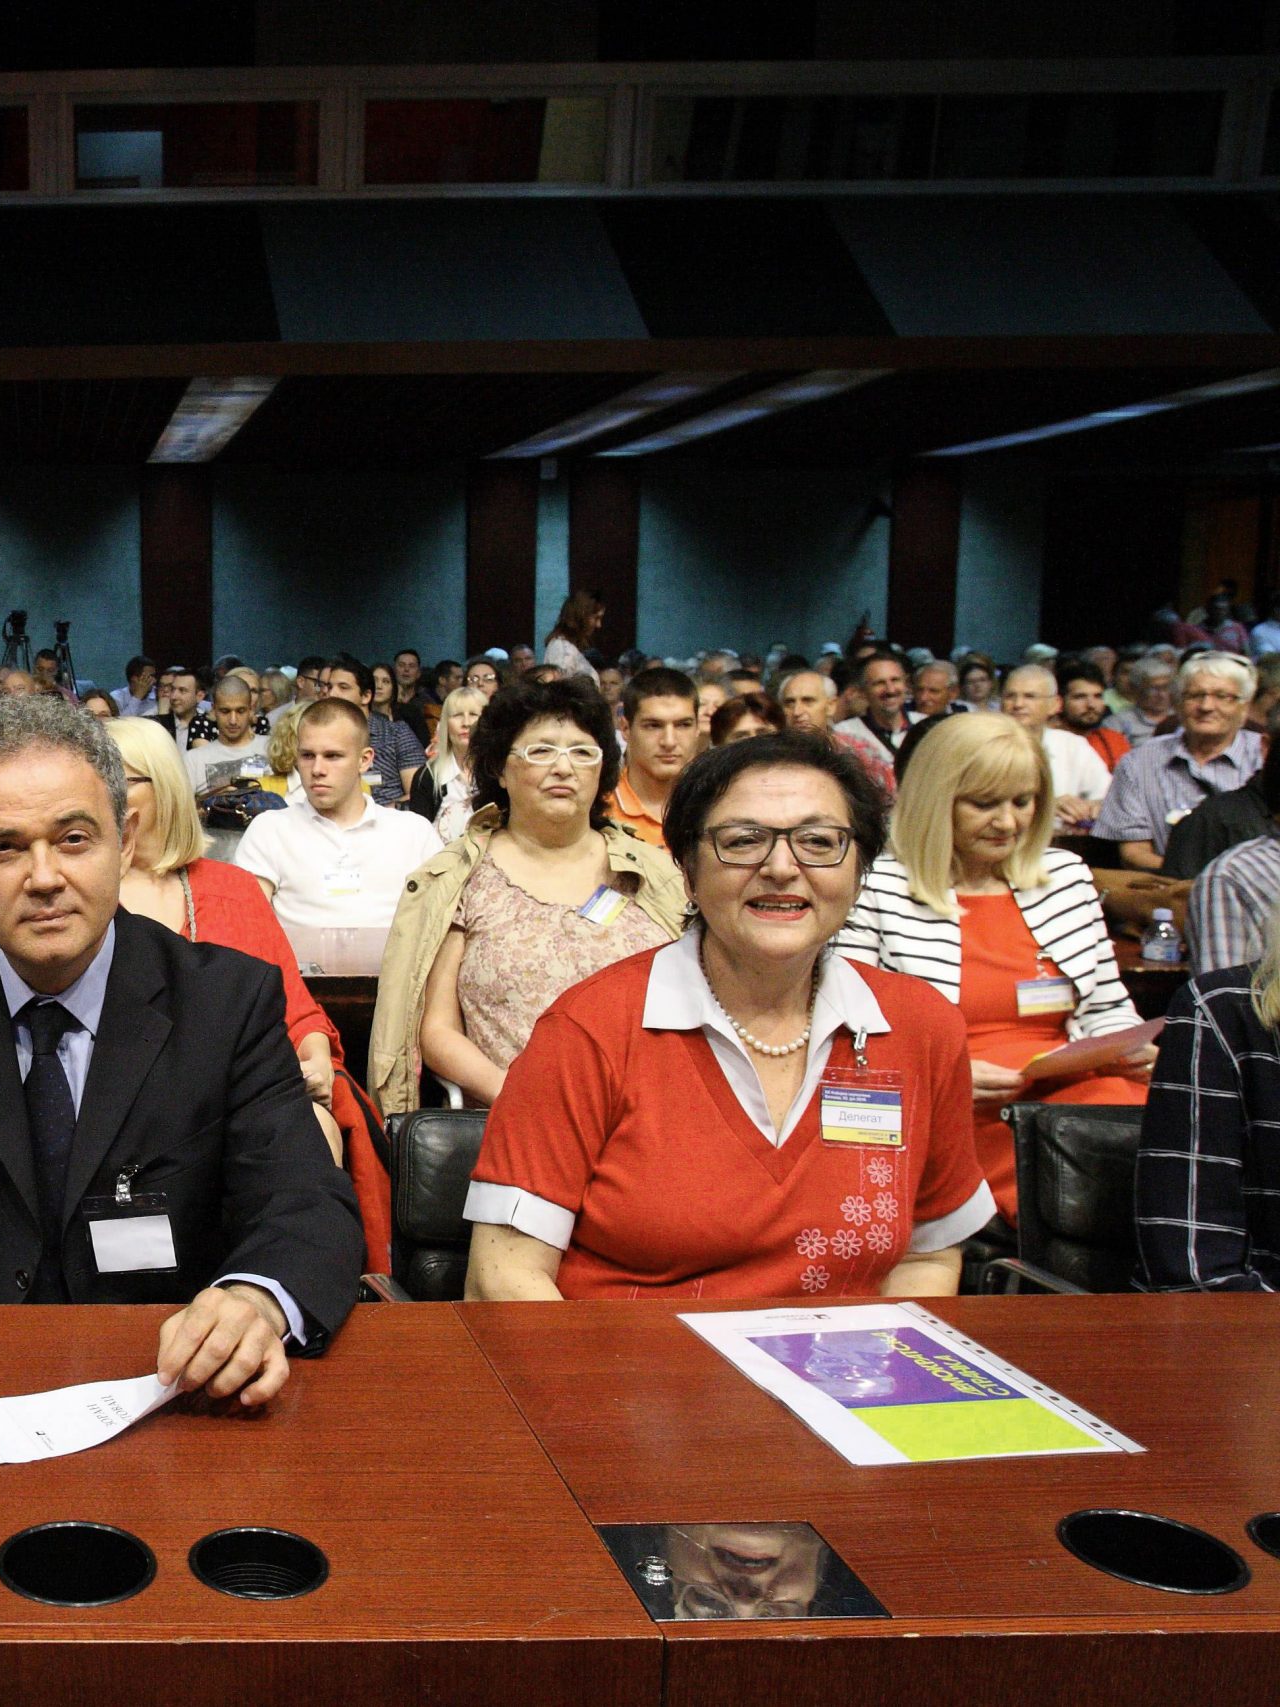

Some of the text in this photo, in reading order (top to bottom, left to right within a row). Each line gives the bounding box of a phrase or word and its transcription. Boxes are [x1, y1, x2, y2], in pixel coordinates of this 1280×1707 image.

[839, 1110, 883, 1123] Делегат
[871, 1331, 989, 1397] ДЕМОКРАТСКА
[934, 1354, 1011, 1396] СТРАНКА
